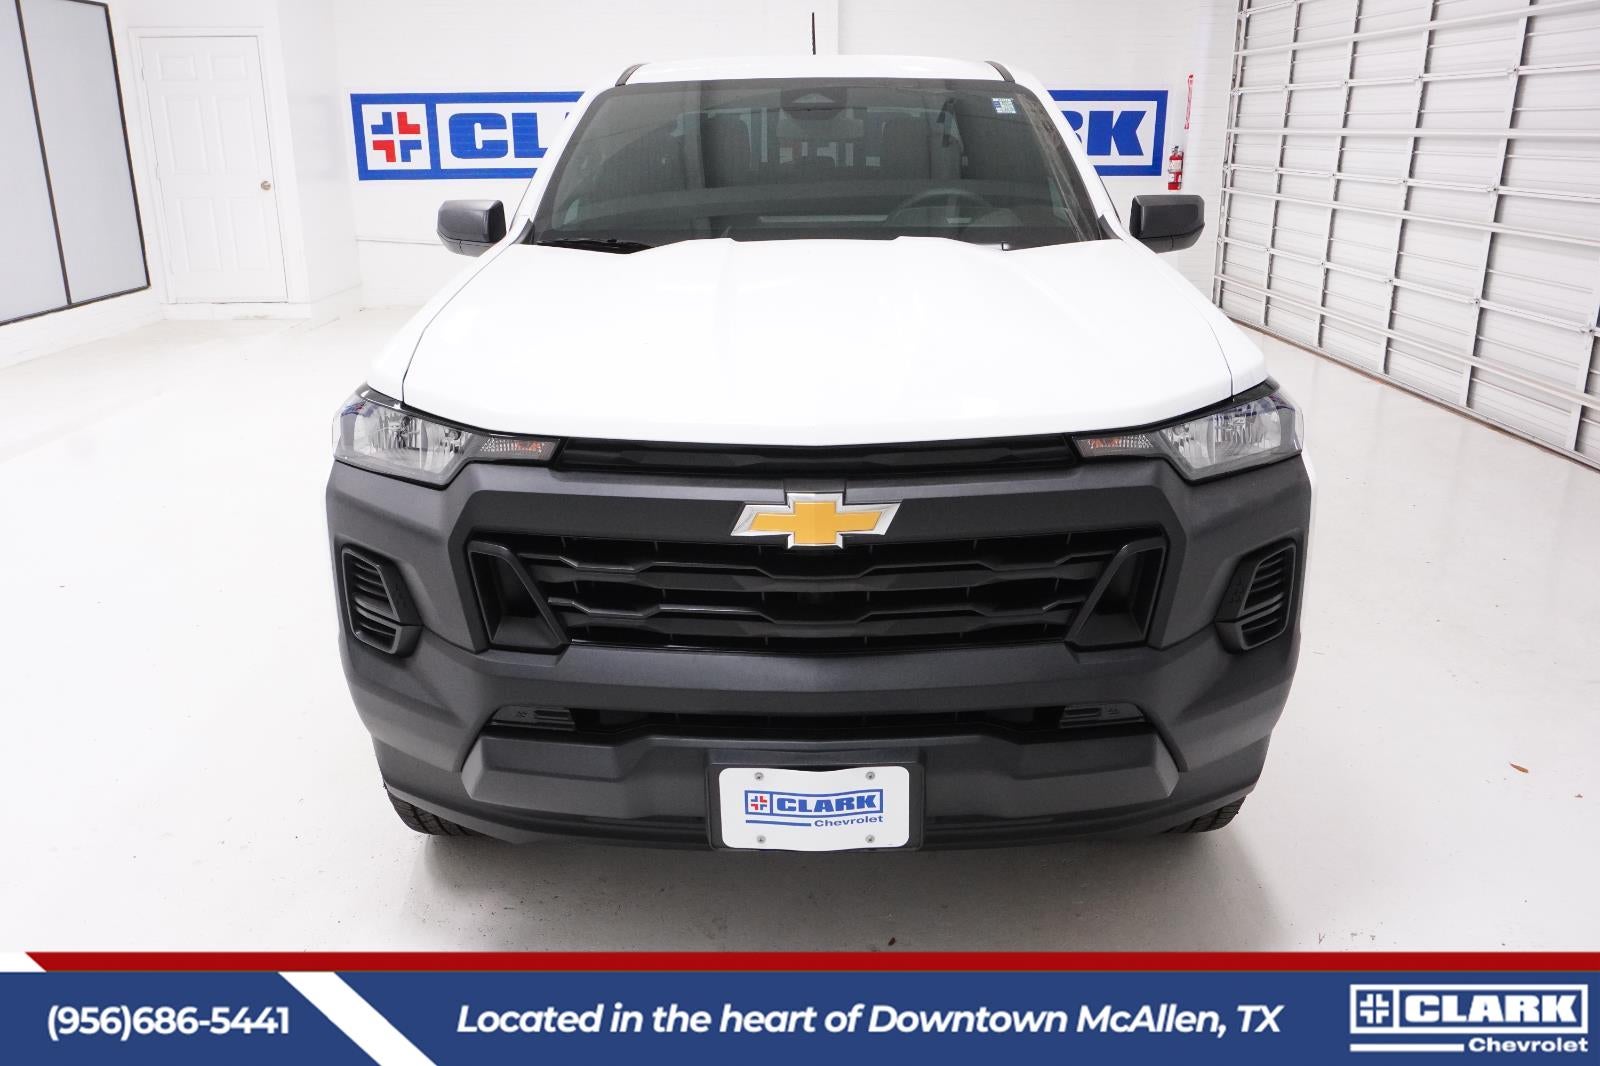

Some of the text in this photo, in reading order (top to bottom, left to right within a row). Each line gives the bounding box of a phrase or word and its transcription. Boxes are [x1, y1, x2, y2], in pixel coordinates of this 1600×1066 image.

[448, 111, 570, 160] CL
[776, 795, 876, 813] CLARK
[813, 815, 884, 828] Chevrolet
